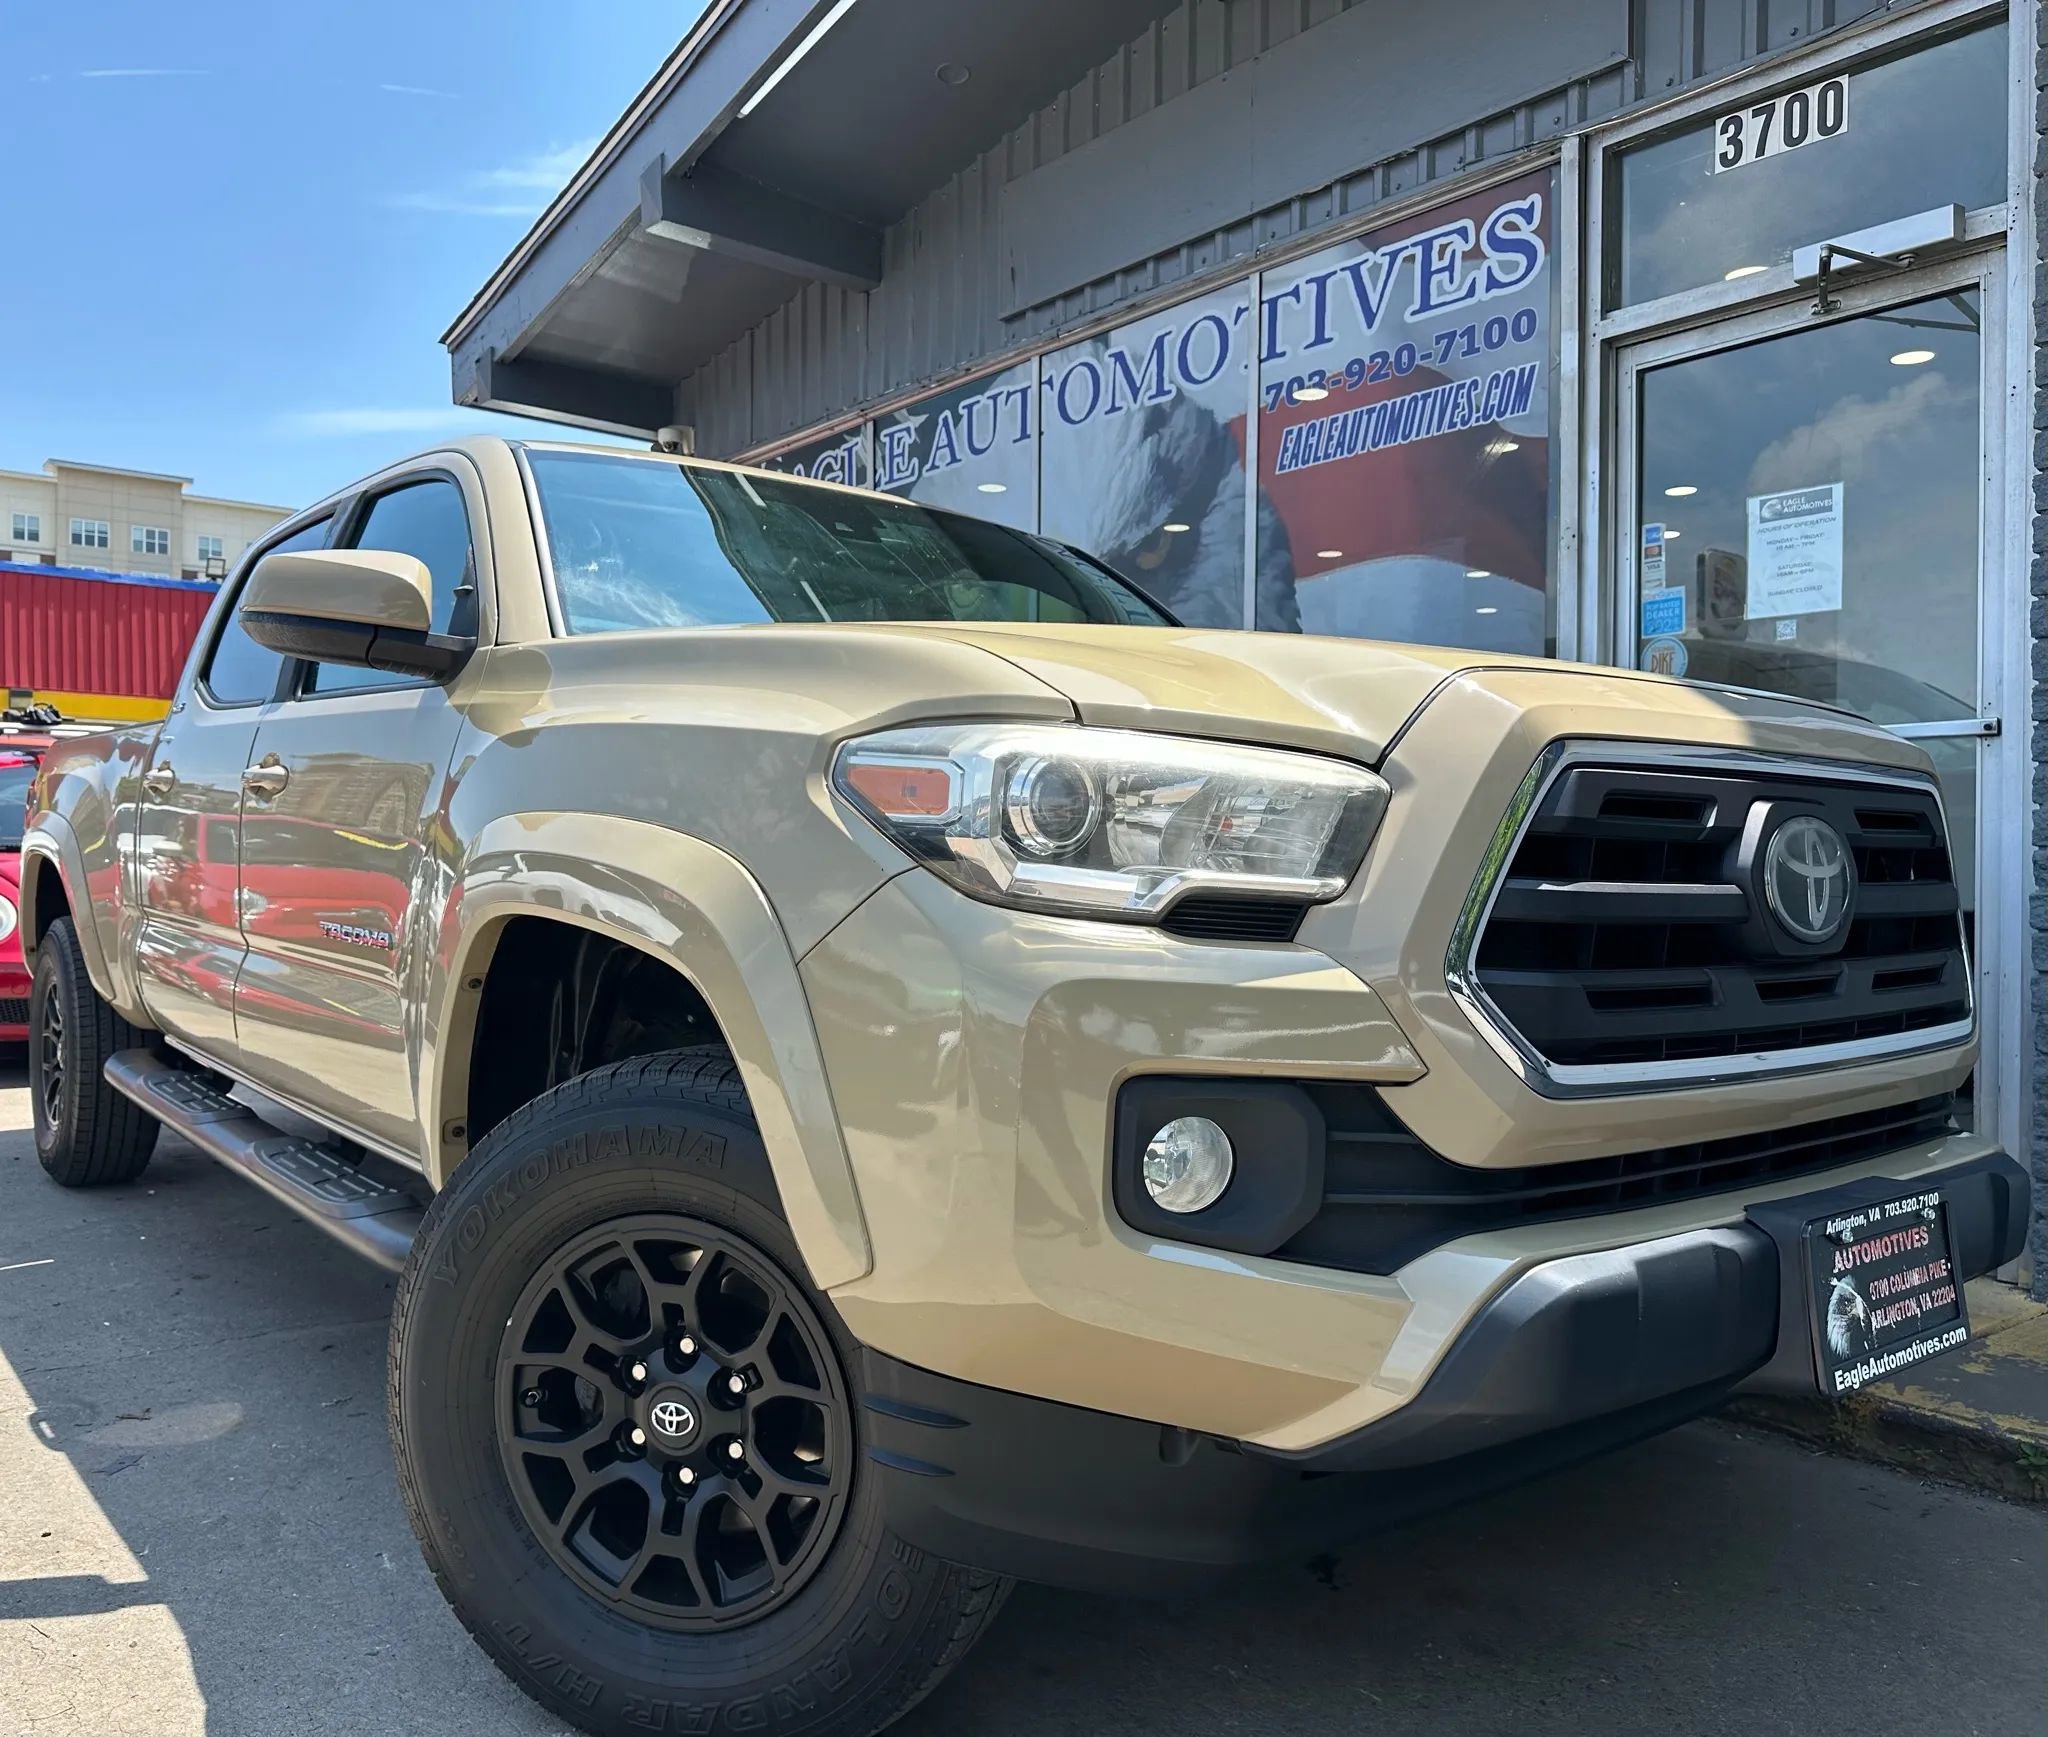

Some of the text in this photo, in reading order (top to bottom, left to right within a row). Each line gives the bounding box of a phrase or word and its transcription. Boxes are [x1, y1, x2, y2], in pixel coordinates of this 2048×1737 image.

[1718, 78, 1846, 170] 3700
[759, 193, 1545, 491] GLE AUTOMOTIVES
[1264, 307, 1538, 413] 703-920-7100
[1275, 361, 1539, 475] EAGLEAUTOMOTIVES.COM
[1783, 496, 1806, 507] EAGLE
[1783, 498, 1833, 513] AUTOMOTIVES
[1794, 516, 1837, 529] OPERATION
[1766, 537, 1793, 546] MONDAY
[1646, 607, 1680, 619] DEALER
[1651, 651, 1675, 675] PIKE
[319, 920, 390, 951] TACOMA
[433, 1122, 729, 1288] YOKOHAMA
[1826, 1192, 1939, 1236] Arlington, VA 703.920.7100
[1833, 1225, 1929, 1273] AUTOMOTIVES
[1870, 1259, 1947, 1300] 3700 COLUMBIA PIKE
[1871, 1284, 1956, 1329] ARLINGTON, VA 22204
[1834, 1326, 1967, 1391] EagleAutomotives.com
